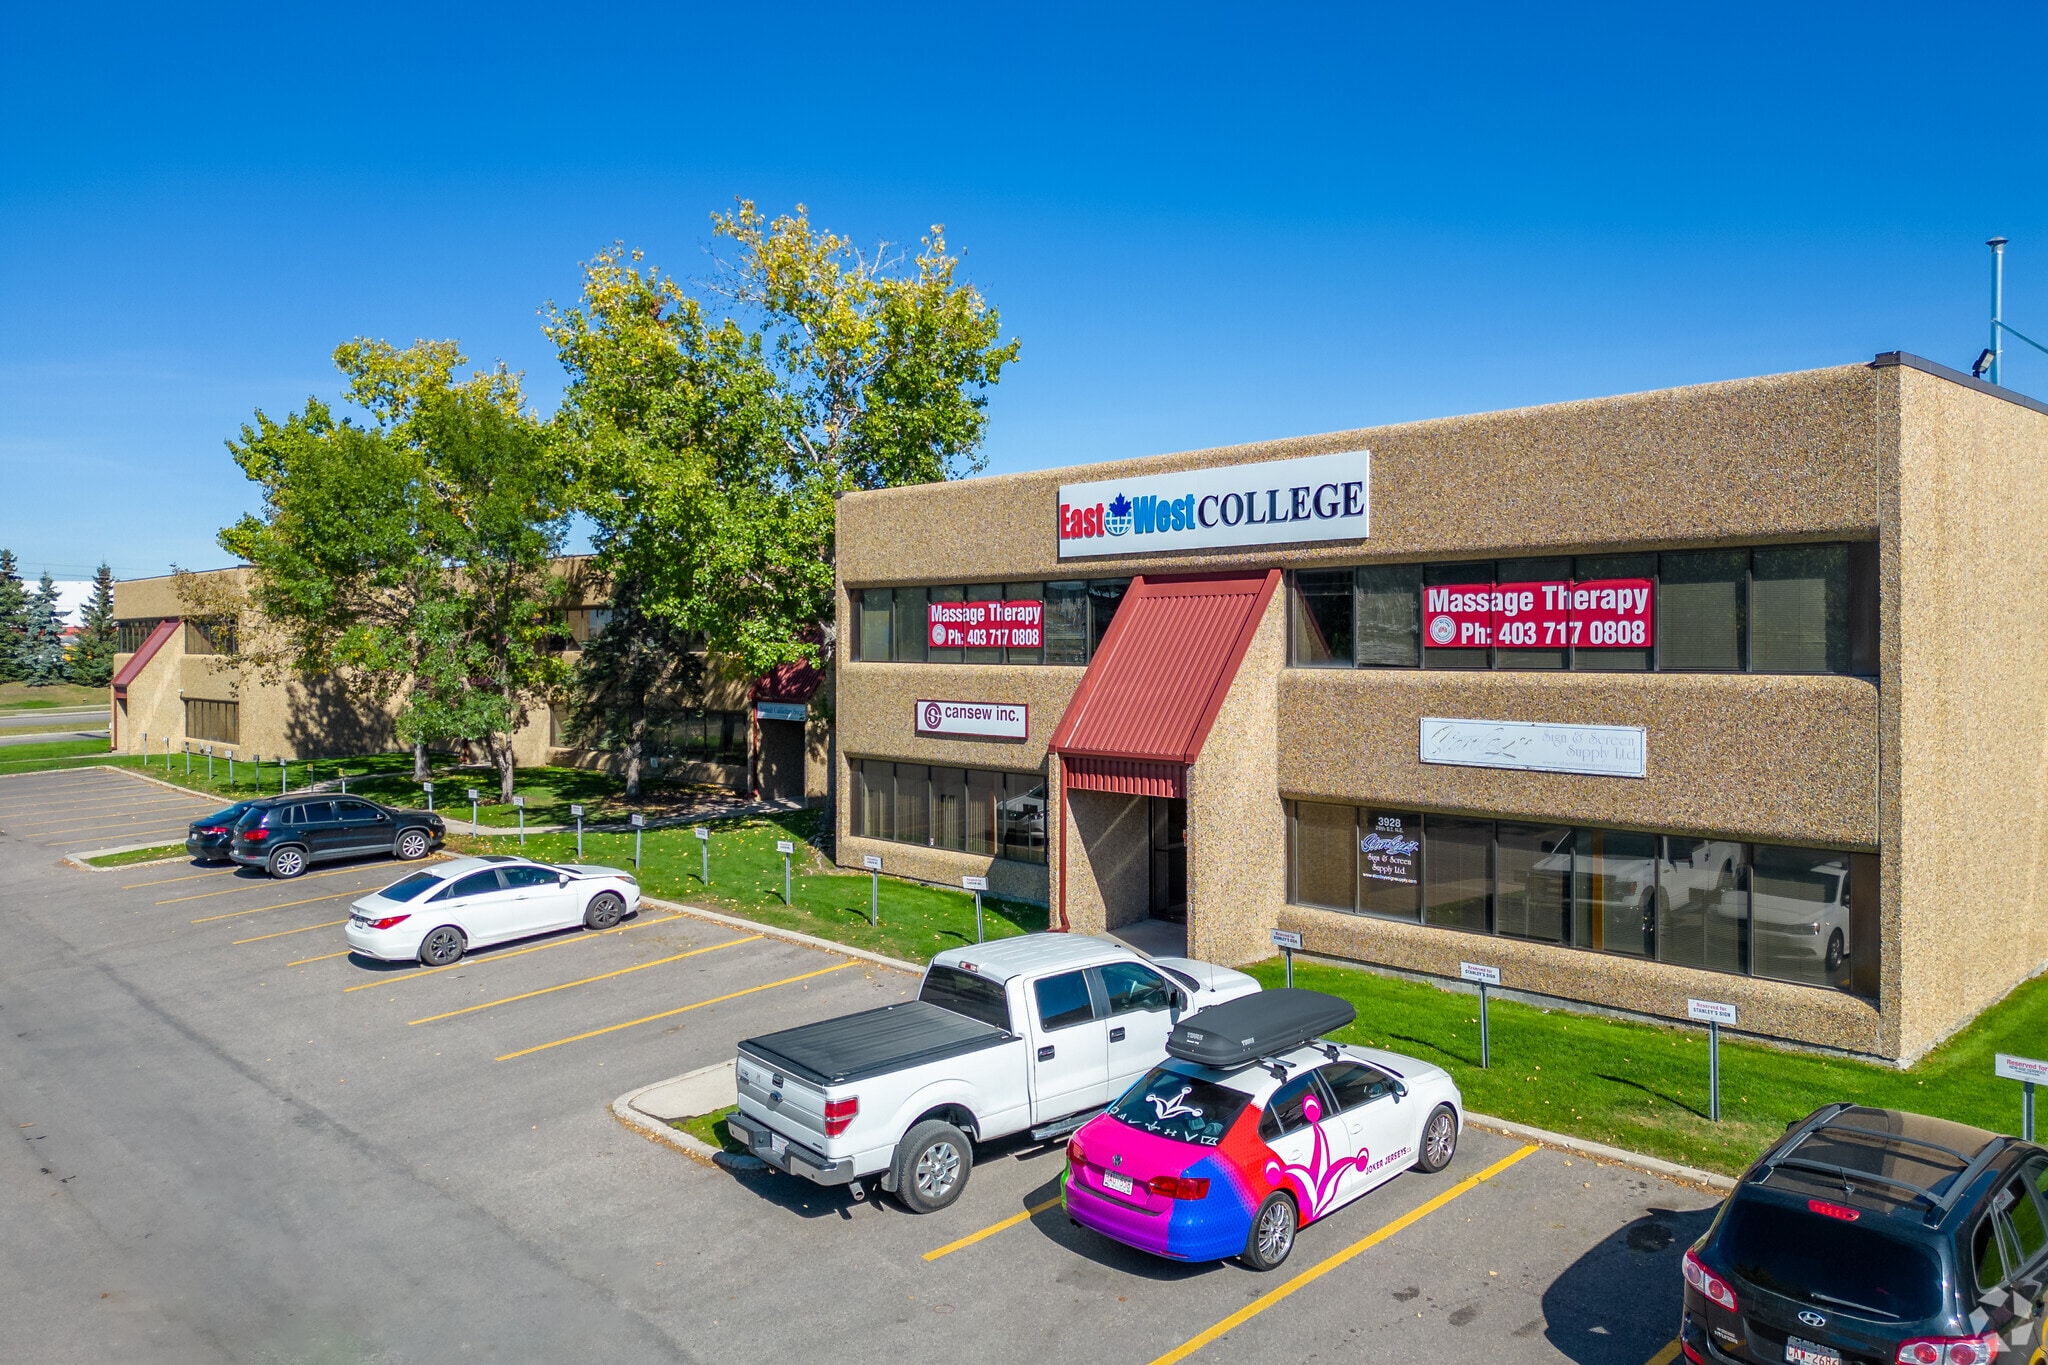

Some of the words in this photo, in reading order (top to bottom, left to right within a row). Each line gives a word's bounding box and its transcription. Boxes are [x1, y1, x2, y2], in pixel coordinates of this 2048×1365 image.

[1060, 503, 1105, 540] East
[1133, 493, 1196, 534] West
[1198, 481, 1365, 529] COLLEGE
[1428, 588, 1534, 616] Massage
[1542, 585, 1649, 615] Therapy
[931, 605, 985, 625] Massage
[988, 603, 1041, 625] Therapy
[948, 629, 964, 645] Ph:
[967, 629, 986, 645] 403
[989, 629, 1008, 645] 717
[1012, 629, 1040, 645] 0808
[1461, 622, 1493, 644] Ph:
[1499, 622, 1537, 644] 403
[1543, 621, 1582, 644] 717
[1589, 620, 1645, 644] 0808
[945, 706, 992, 720] cansew
[996, 706, 1019, 722] inc.
[1542, 730, 1567, 747] Sign
[1572, 731, 1583, 743] &
[1588, 732, 1635, 747] Screen
[1566, 744, 1609, 761] Supply
[1615, 748, 1640, 761] Ltd.
[1378, 817, 1401, 827] 3928
[1693, 1007, 1718, 1015] STANLEY'S
[1696, 1002, 1718, 1010] Reserved
[2006, 1059, 2037, 1069] Reserved
[1366, 1159, 1383, 1175] JOKER
